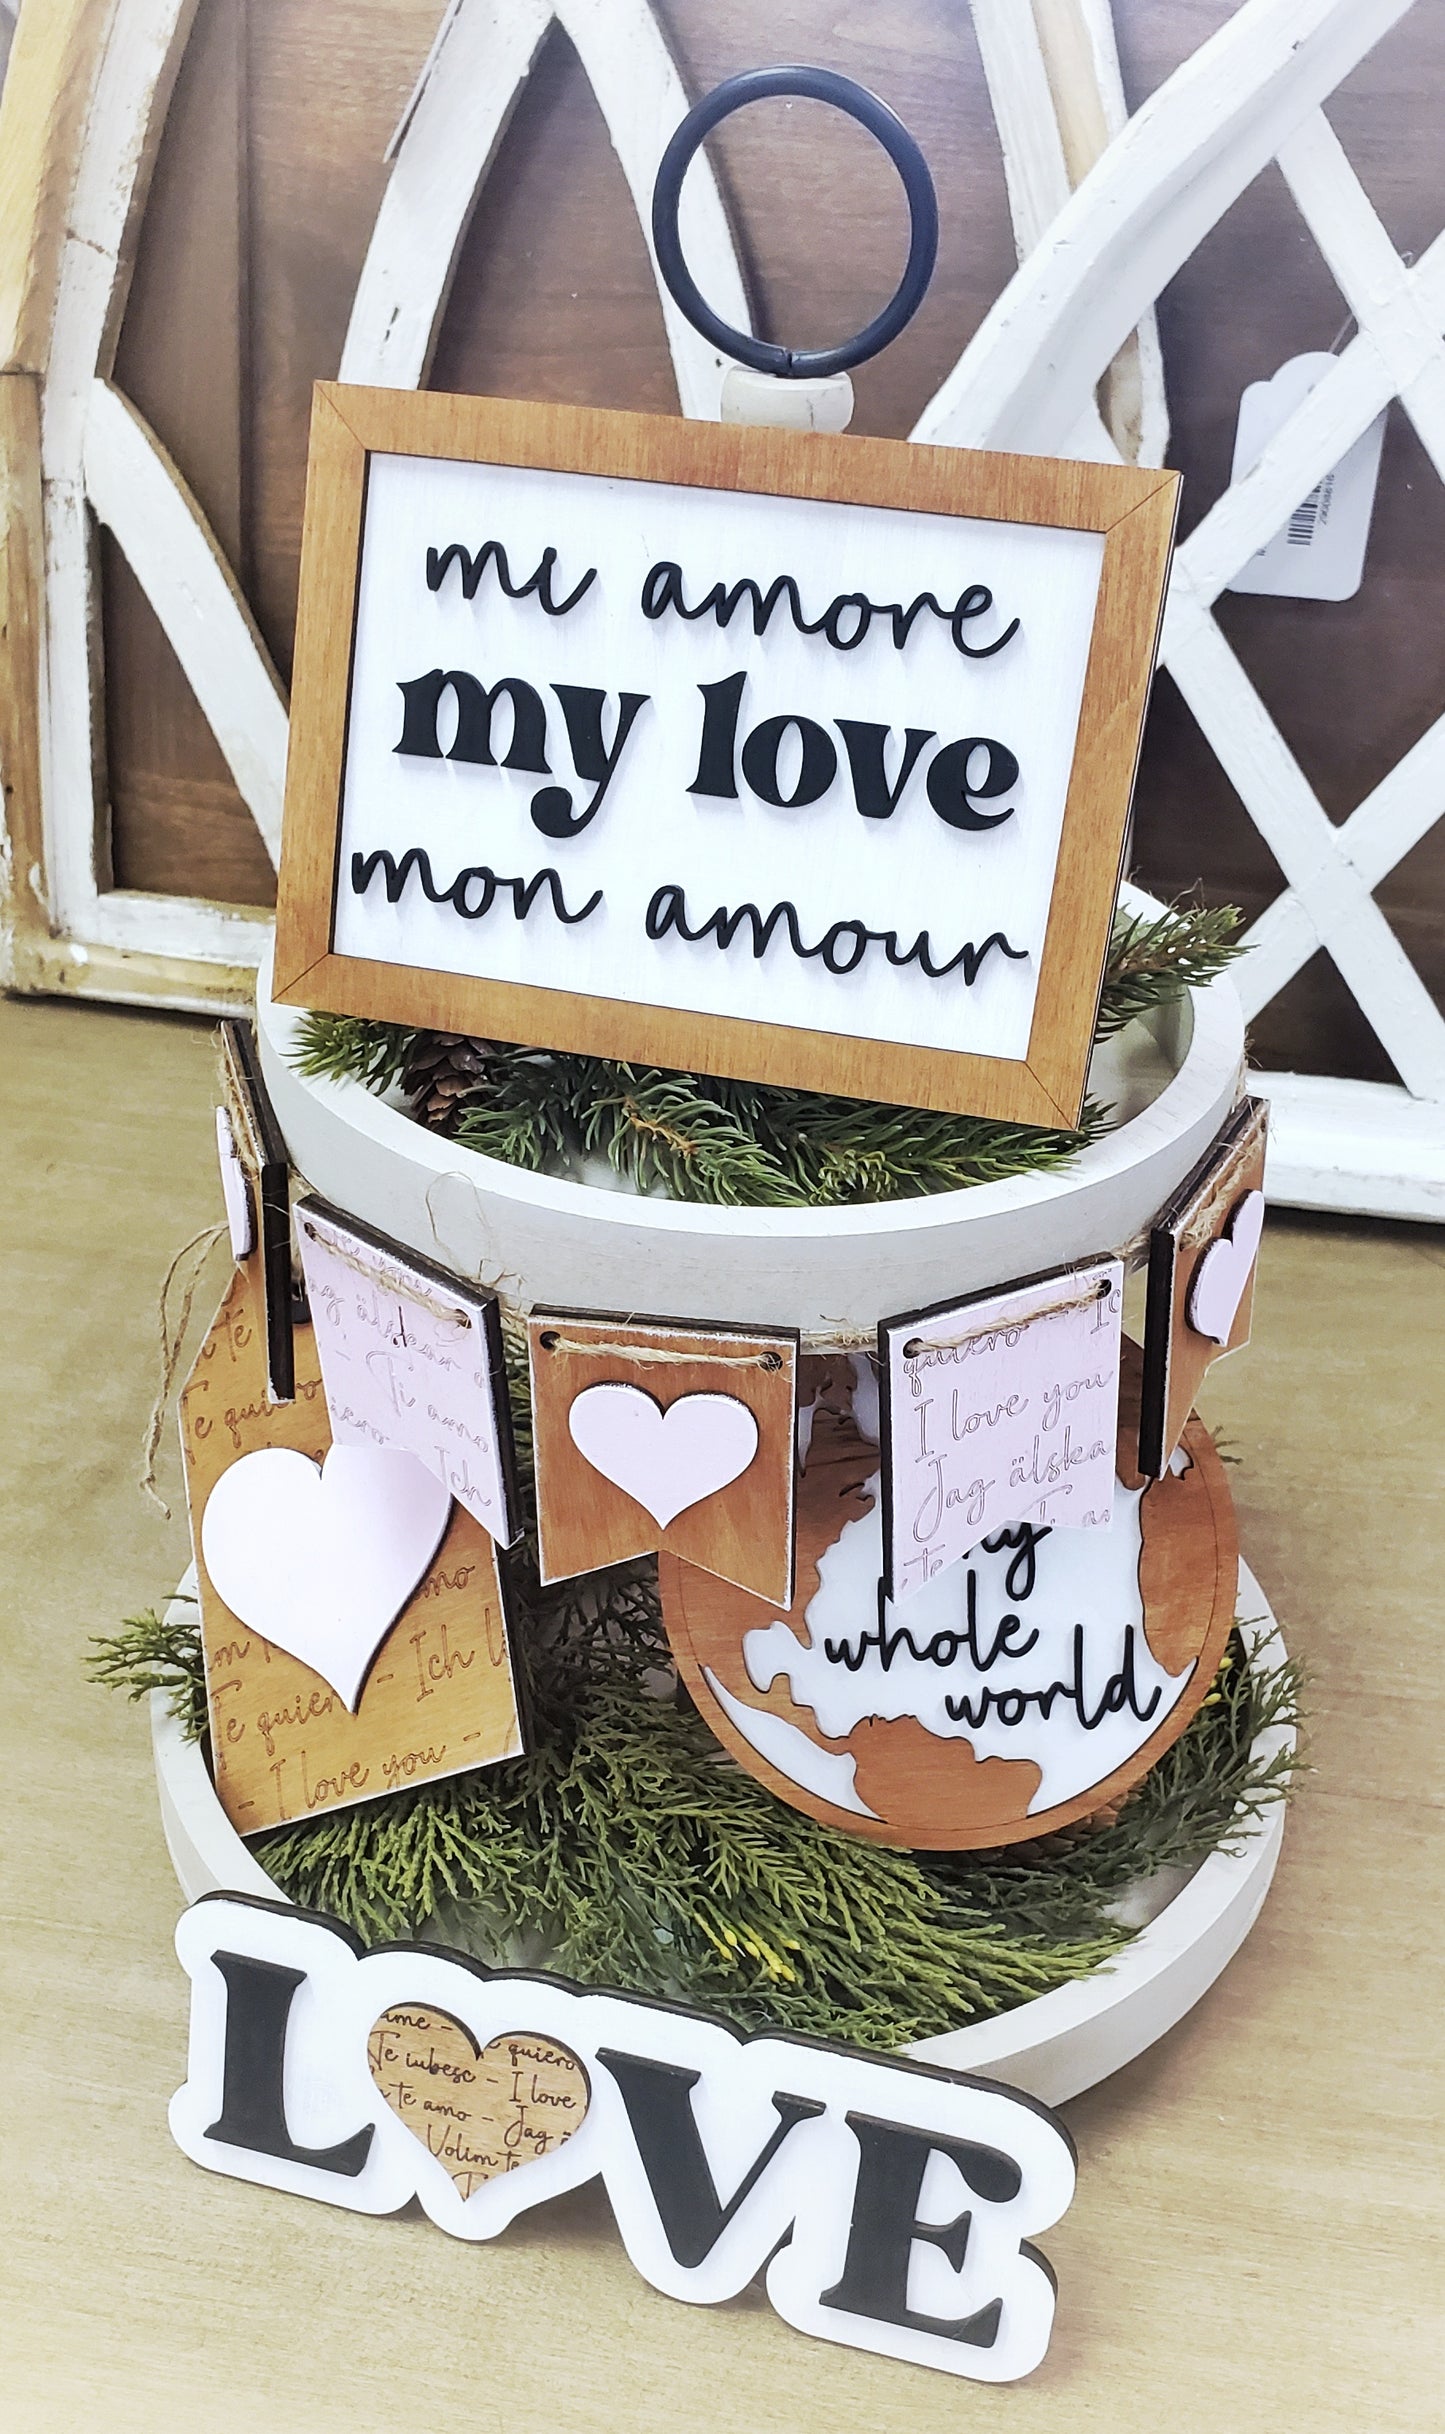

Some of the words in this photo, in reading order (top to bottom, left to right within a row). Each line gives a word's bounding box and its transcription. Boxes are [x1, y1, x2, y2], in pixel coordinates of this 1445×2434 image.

[427, 541, 597, 616] mi
[641, 562, 1020, 658] amore
[392, 669, 651, 838] my
[685, 671, 1019, 831] love
[352, 848, 603, 925] mon
[645, 885, 1028, 986] amour
[914, 1399, 935, 1462] I
[952, 1389, 1029, 1440] love
[1043, 1371, 1114, 1431] you
[913, 1454, 995, 1543] Jag
[410, 1624, 475, 1702] Ich
[825, 1576, 1039, 1671] whole
[945, 1624, 1162, 1730] world
[270, 1758, 292, 1821] I
[301, 1750, 370, 1809] love
[383, 1745, 447, 1790] you
[405, 2047, 477, 2084] iubesc
[508, 2070, 525, 2104] I
[530, 2073, 577, 2109] love
[508, 2043, 576, 2070] quiero
[388, 2081, 418, 2110] te
[423, 2100, 473, 2122] amo
[503, 2105, 554, 2156] Jag
